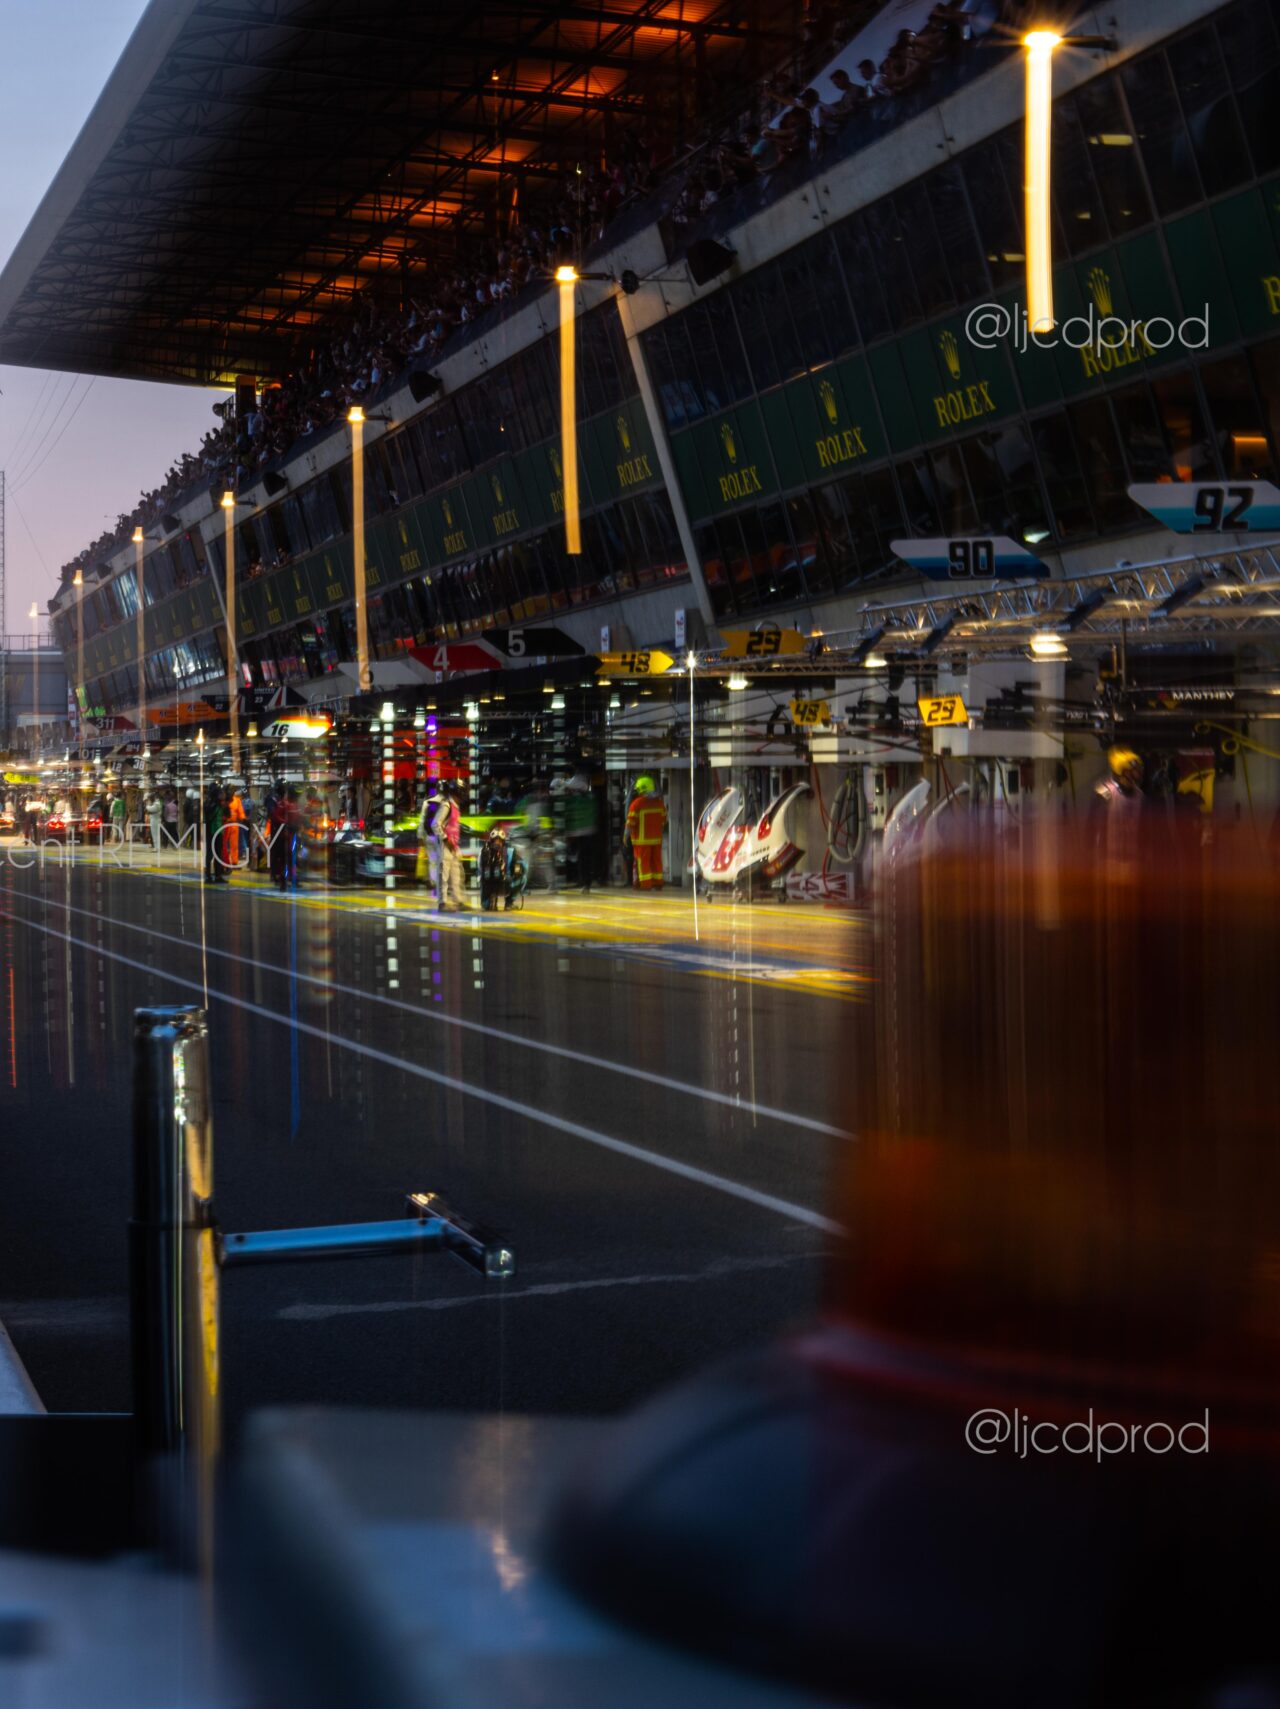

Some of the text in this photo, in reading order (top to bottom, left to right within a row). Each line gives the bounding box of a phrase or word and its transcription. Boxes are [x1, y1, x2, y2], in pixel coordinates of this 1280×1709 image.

[1080, 323, 1158, 378] ROLEX
[933, 380, 997, 428] ROLEX
[815, 426, 868, 468] ROLEX
[617, 454, 652, 487] ROLEX
[720, 465, 762, 502] ROLEX
[492, 509, 520, 536] ROLEX
[1192, 487, 1254, 533] 92
[948, 540, 996, 578] 90
[432, 645, 450, 671] 4
[507, 629, 526, 657] 5
[746, 631, 782, 655] 29
[927, 699, 956, 722] 29
[1172, 690, 1235, 701] MANTHEY
[271, 723, 290, 736] 16
